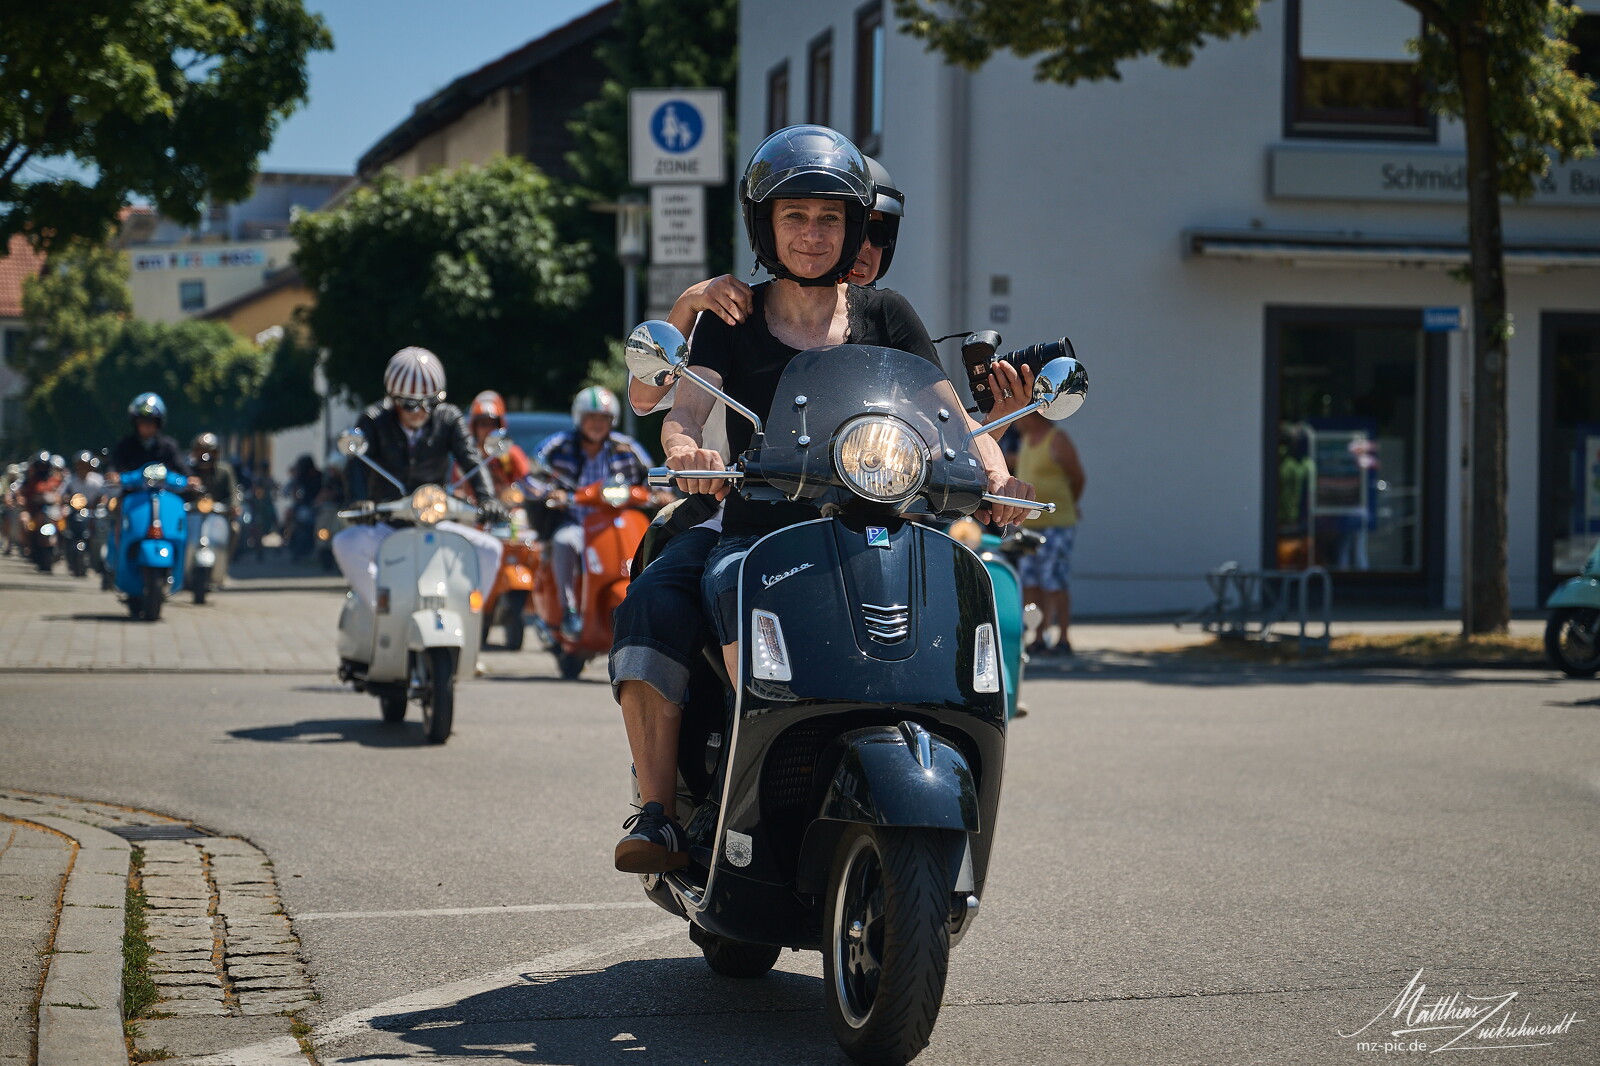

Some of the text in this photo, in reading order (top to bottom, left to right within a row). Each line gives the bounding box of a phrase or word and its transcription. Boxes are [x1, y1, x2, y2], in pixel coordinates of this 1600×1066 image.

[655, 158, 700, 175] ZONE
[1381, 162, 1466, 191] Schmid
[761, 562, 815, 590] Vespa
